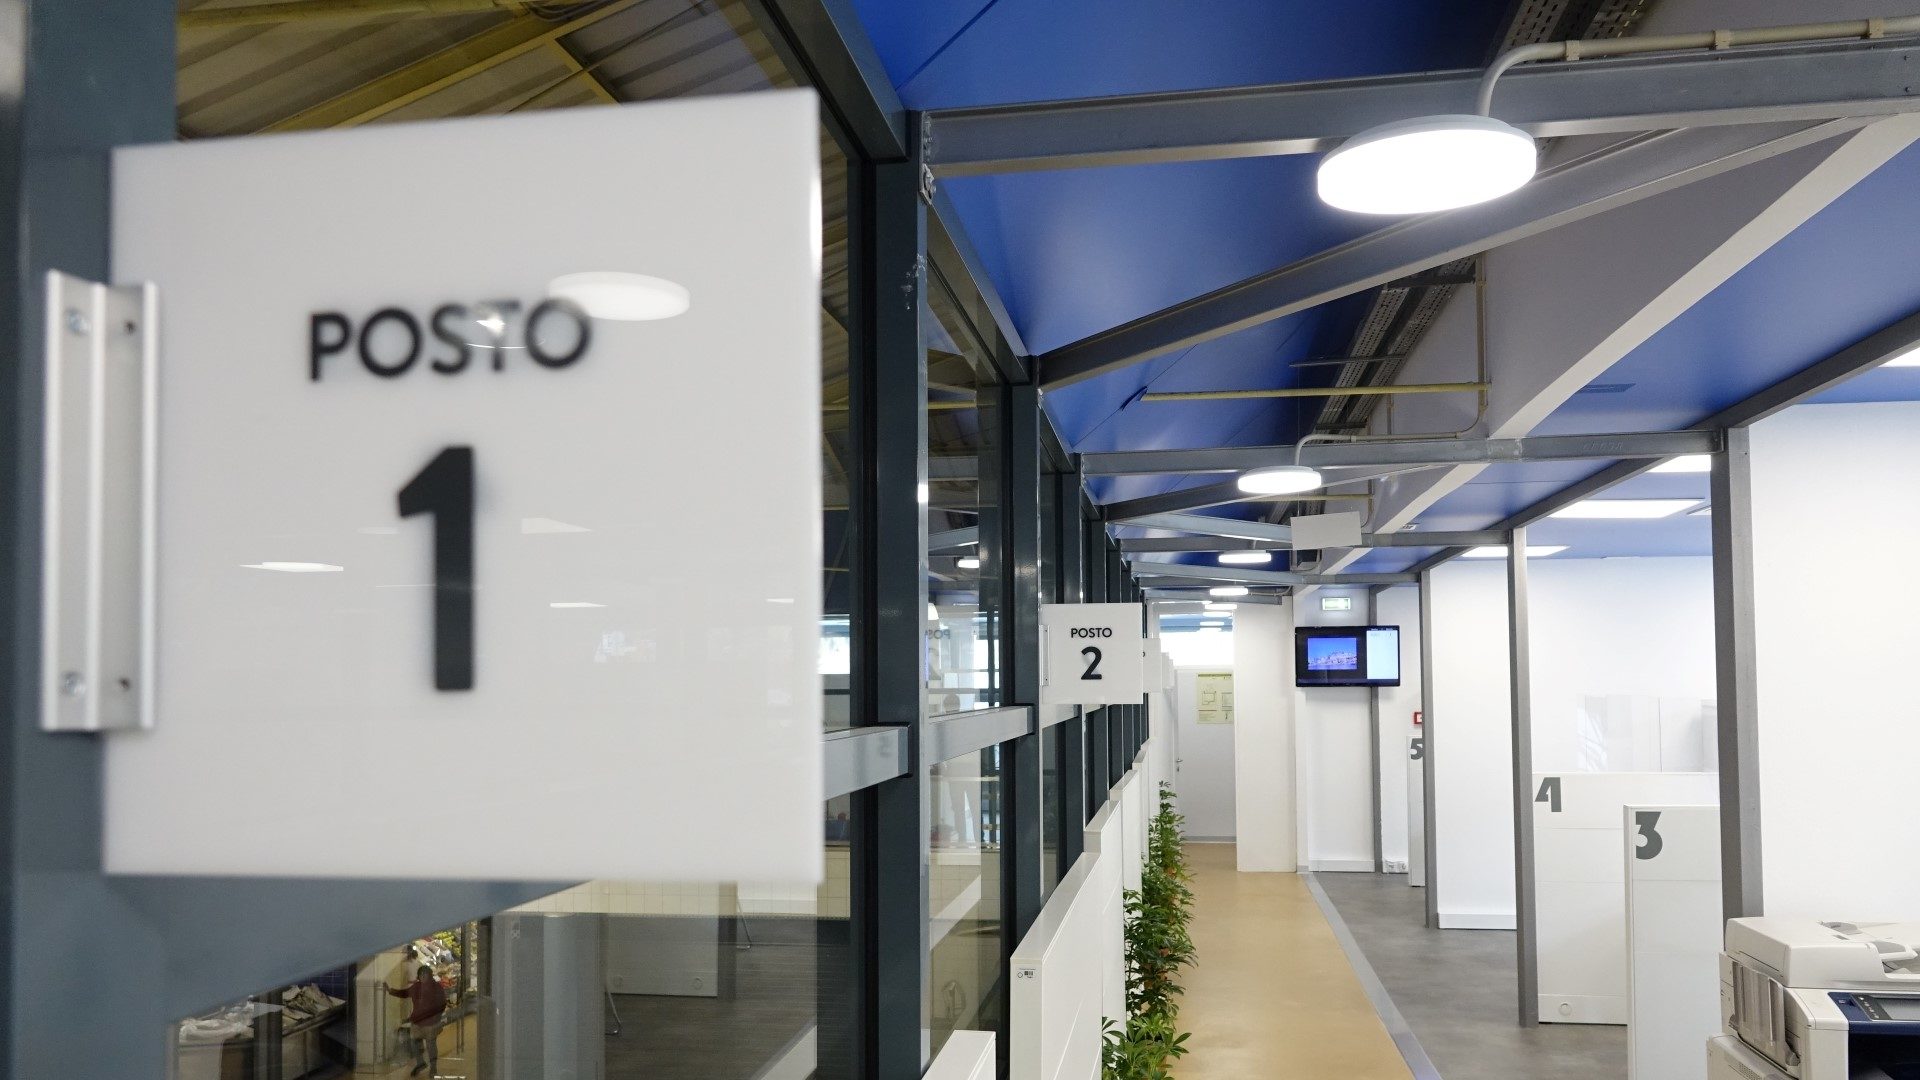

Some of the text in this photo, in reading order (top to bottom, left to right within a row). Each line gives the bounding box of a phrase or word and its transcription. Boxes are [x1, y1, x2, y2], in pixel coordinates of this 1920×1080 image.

[307, 297, 594, 383] POSTO
[397, 446, 475, 692] 1
[1070, 627, 1113, 639] POSTO
[1080, 646, 1103, 681] 2
[1410, 737, 1424, 761] 5
[1534, 776, 1562, 813] 4
[1635, 810, 1663, 860] 3
